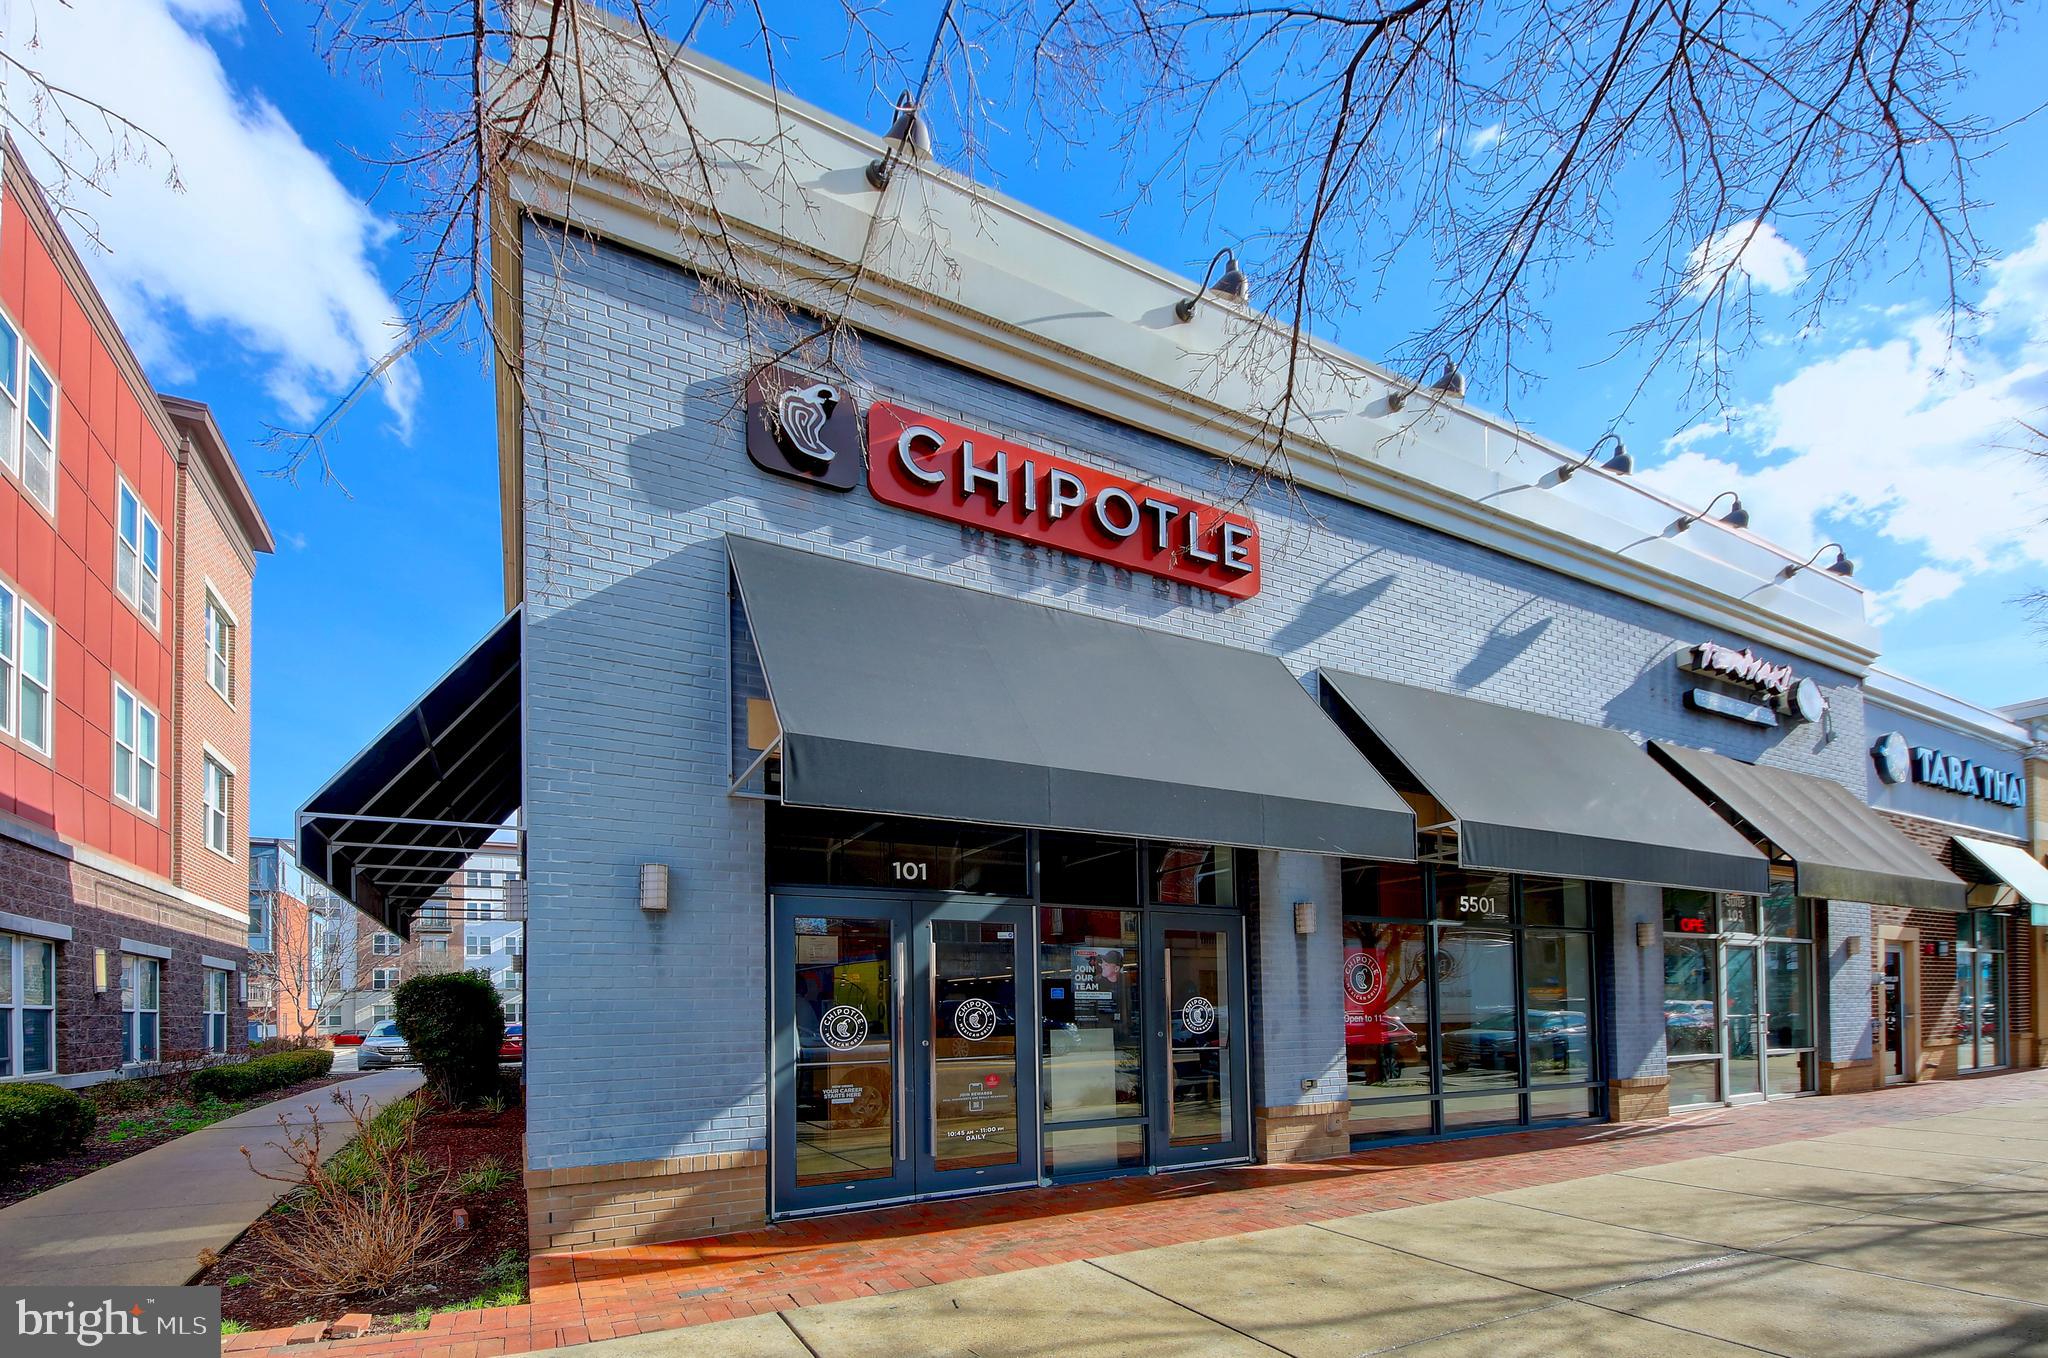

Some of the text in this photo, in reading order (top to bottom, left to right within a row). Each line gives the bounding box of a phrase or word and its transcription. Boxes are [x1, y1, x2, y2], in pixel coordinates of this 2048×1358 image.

[897, 425, 1253, 573] CHIPOTLE
[1916, 746, 1979, 796] TARA
[892, 861, 927, 880] 101
[1460, 895, 1495, 913] 5501
[1727, 909, 1744, 922] 103
[1074, 965, 1095, 973] JOIN
[1345, 956, 1380, 976] CHIPOTLE
[958, 1001, 993, 1017] CHIPOTLE
[1185, 999, 1212, 1013] CHIPOTLE
[823, 1008, 864, 1026] CHIPOTLE
[1344, 1014, 1364, 1024] Open
[1365, 1014, 1373, 1023] to
[825, 1032, 850, 1047] MEXICAN
[947, 1129, 966, 1137] 10:45
